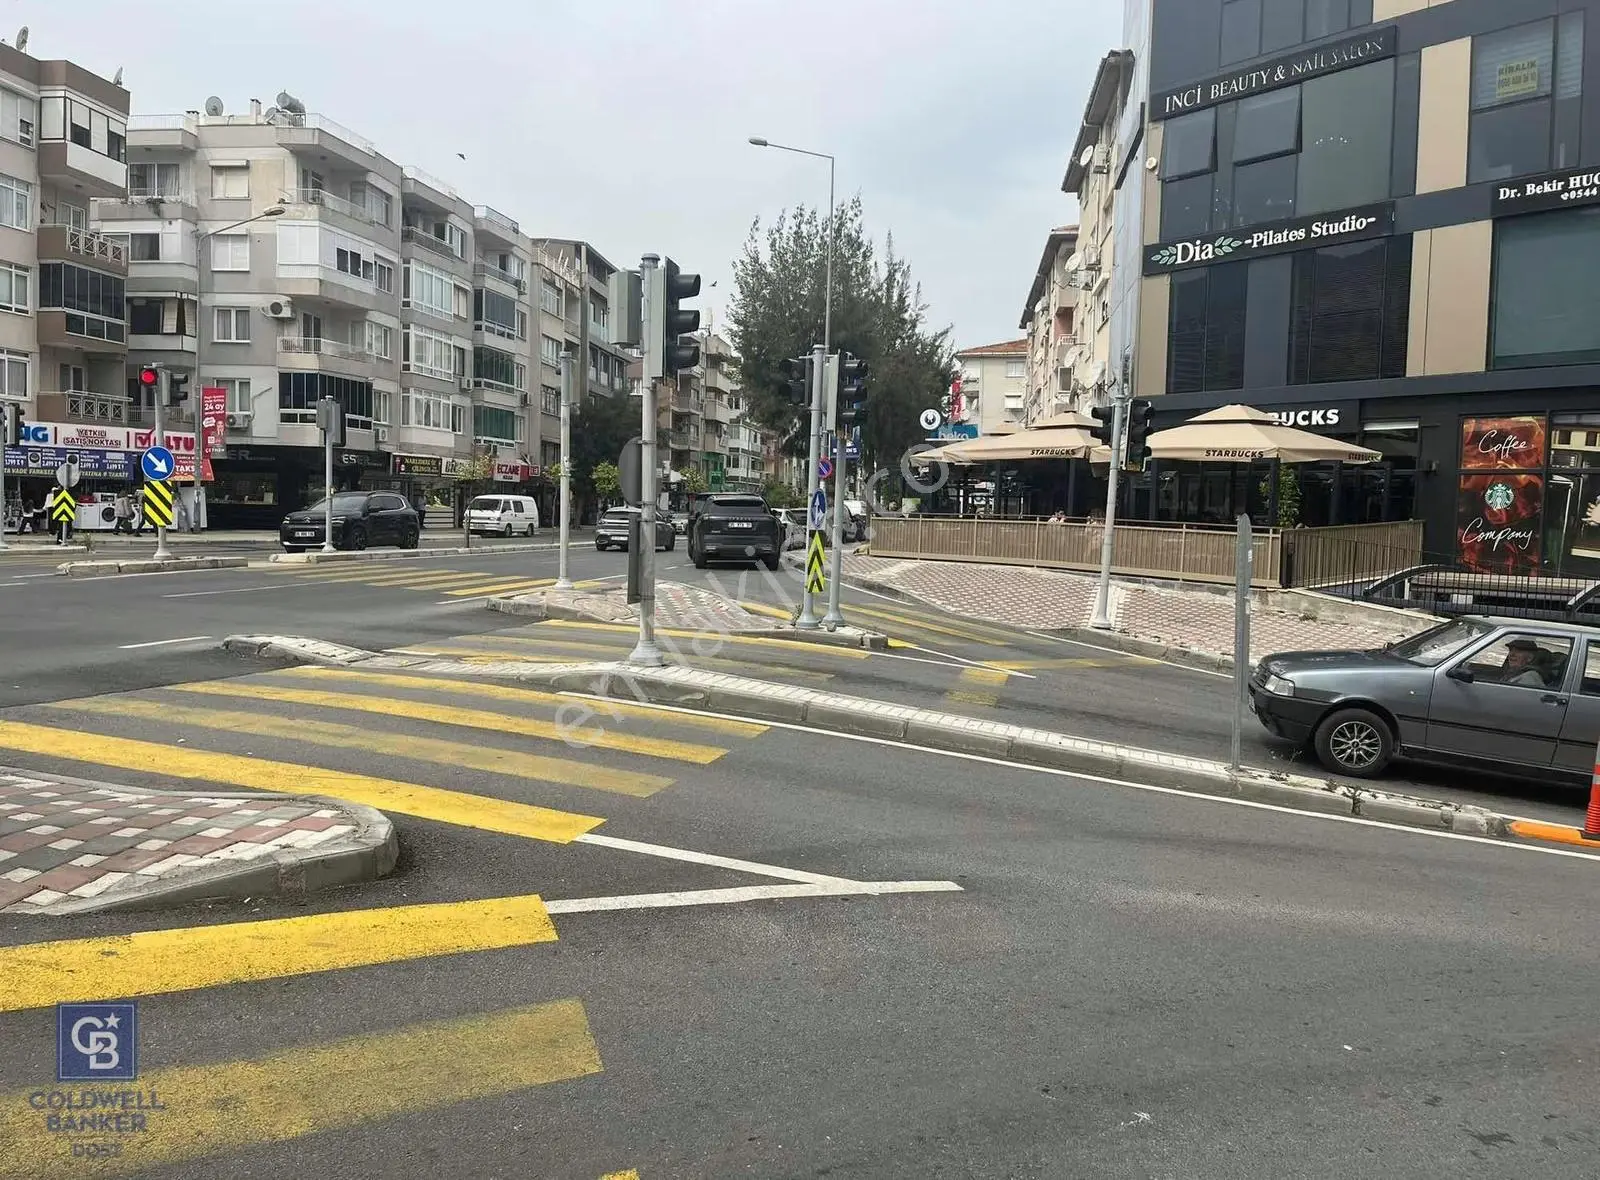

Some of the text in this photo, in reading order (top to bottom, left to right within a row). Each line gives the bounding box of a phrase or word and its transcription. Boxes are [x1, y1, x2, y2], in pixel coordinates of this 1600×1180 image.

[1210, 68, 1270, 100] BEAUTY
[1274, 64, 1286, 82] &
[1331, 36, 1383, 66] SALON
[1498, 187, 1521, 200] Dr.
[1526, 180, 1565, 196] Bekir
[1569, 186, 1598, 200] 0544
[1174, 238, 1216, 265] Dia
[1030, 448, 1076, 456] STARBUCKS
[1205, 448, 1264, 459] STARBUCKS
[497, 464, 520, 476] ECZANE
[1462, 516, 1534, 552] Company
